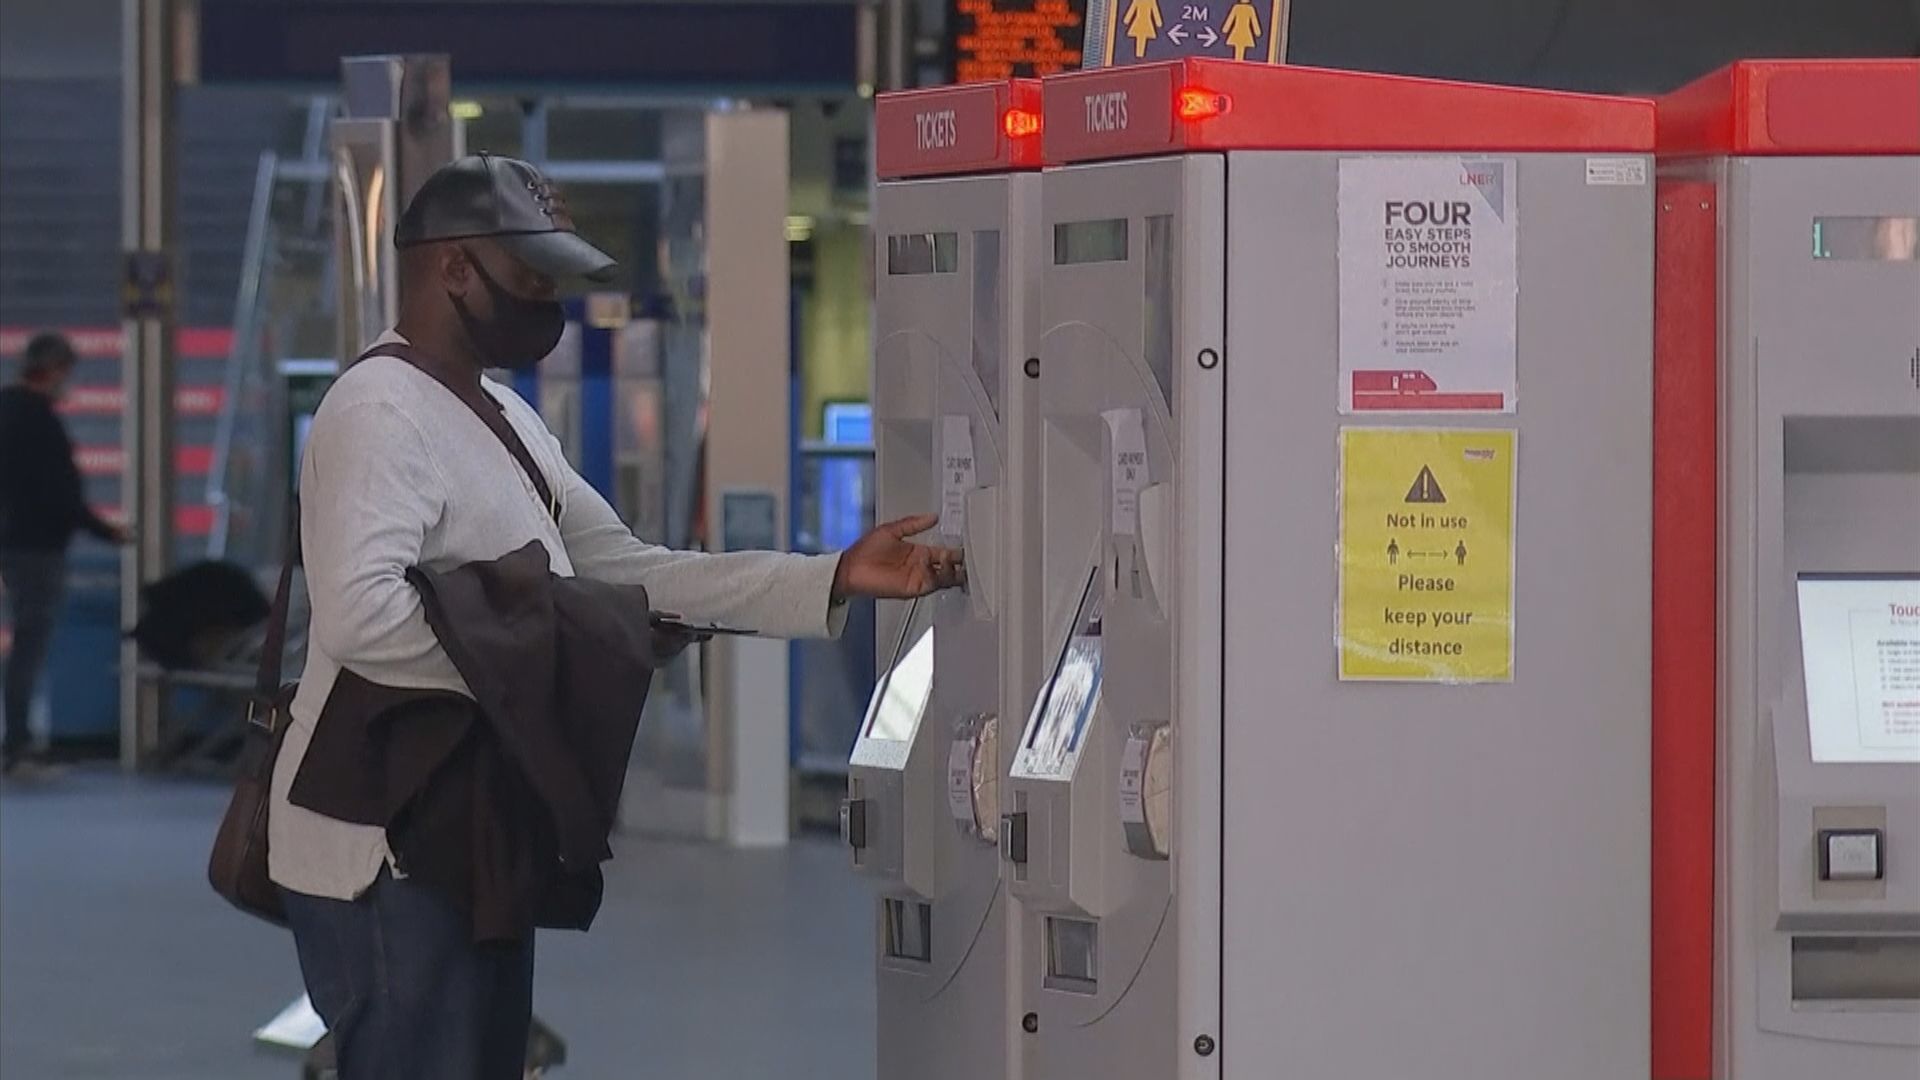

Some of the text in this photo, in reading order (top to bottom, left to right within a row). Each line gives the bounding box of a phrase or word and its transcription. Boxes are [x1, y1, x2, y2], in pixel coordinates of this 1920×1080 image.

[1181, 6, 1209, 22] 2M
[1085, 92, 1128, 133] TICKETS
[915, 110, 957, 150] TICKETS
[1459, 174, 1495, 185] LNER
[1385, 201, 1472, 226] FOUR
[1385, 228, 1472, 240] EASY STEPS
[1386, 242, 1471, 254] TO SMOOTH
[1386, 255, 1471, 268] JOURNEYS
[1386, 513, 1467, 529] Not in use
[1398, 574, 1455, 591] Please
[1384, 607, 1472, 627] keep your
[1388, 638, 1463, 655] distance
